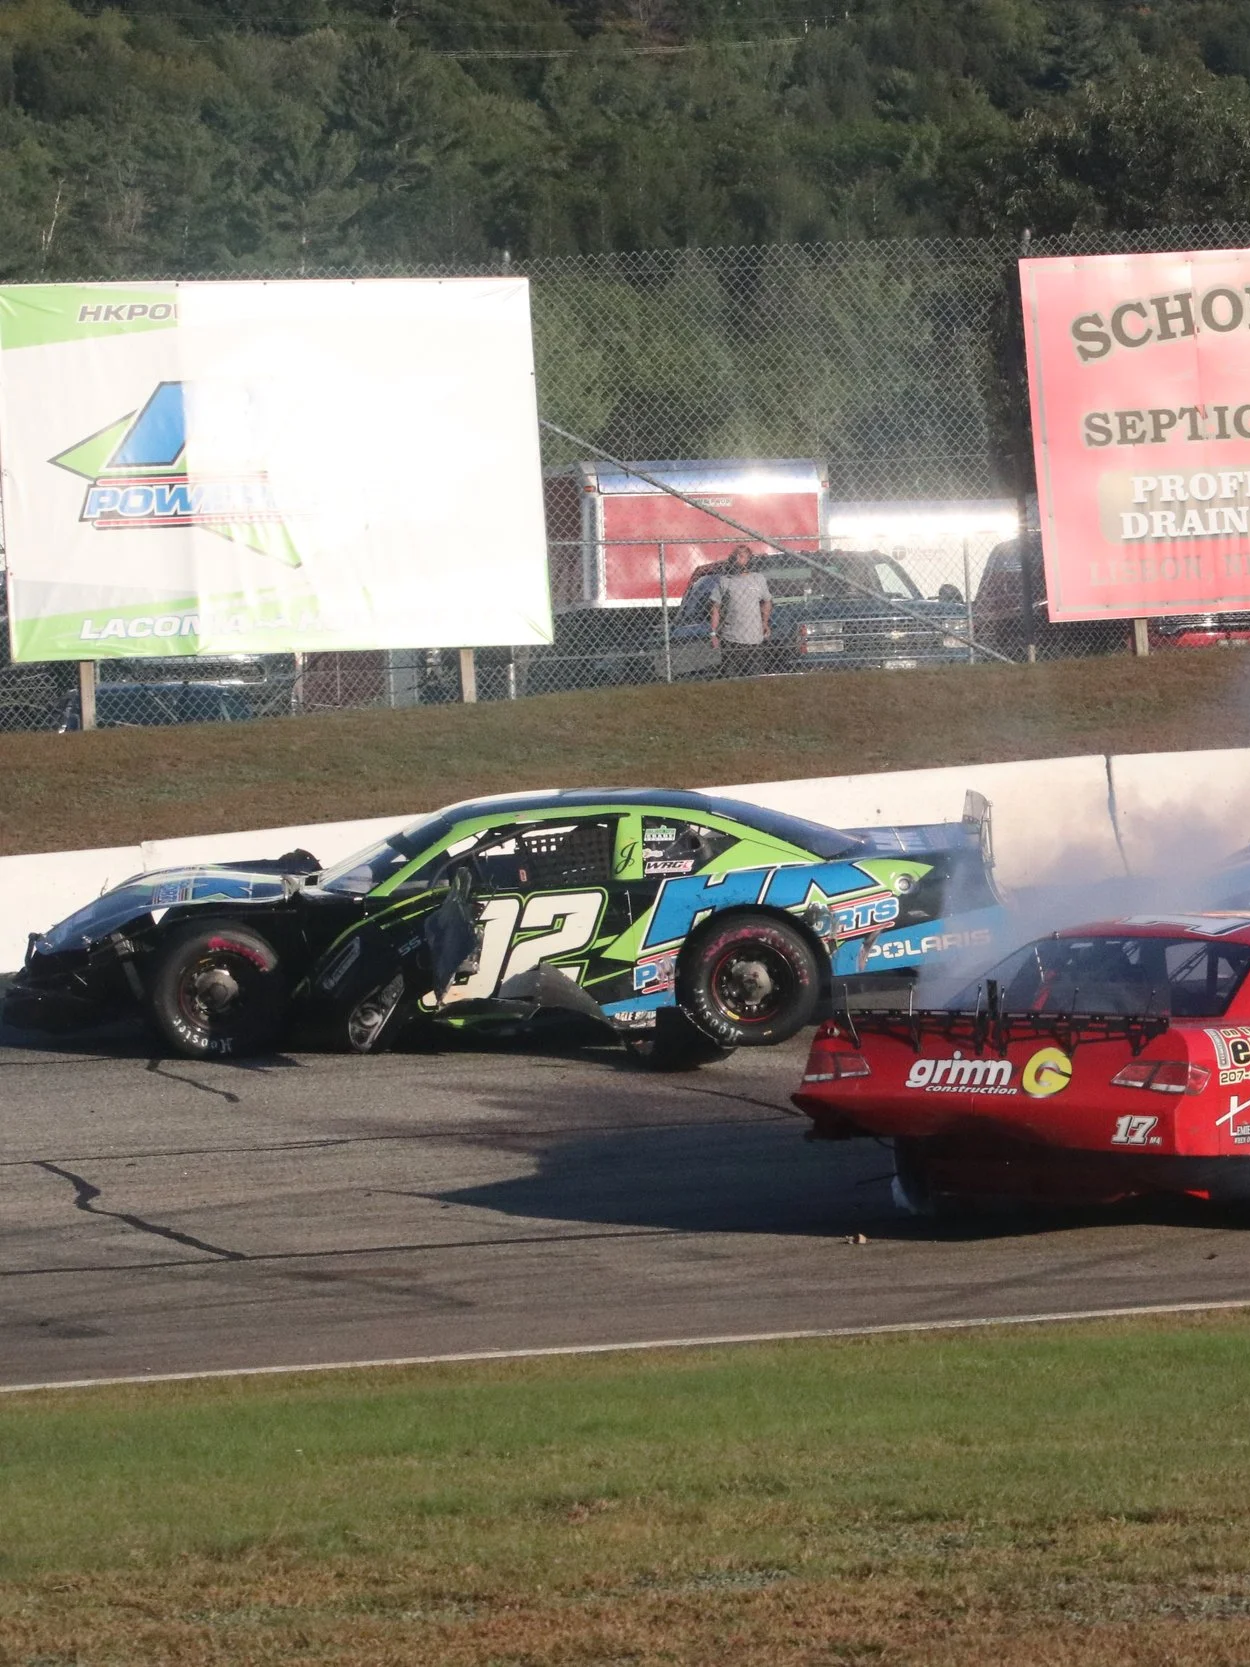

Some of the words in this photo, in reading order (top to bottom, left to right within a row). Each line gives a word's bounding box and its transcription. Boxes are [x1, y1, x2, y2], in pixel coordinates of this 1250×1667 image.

[1120, 506, 1249, 540] DRAIN
[866, 929, 991, 961] POLARIS
[1222, 1029, 1239, 1037] on
[925, 1084, 1018, 1095] construction
[1111, 1115, 1159, 1145] 17
